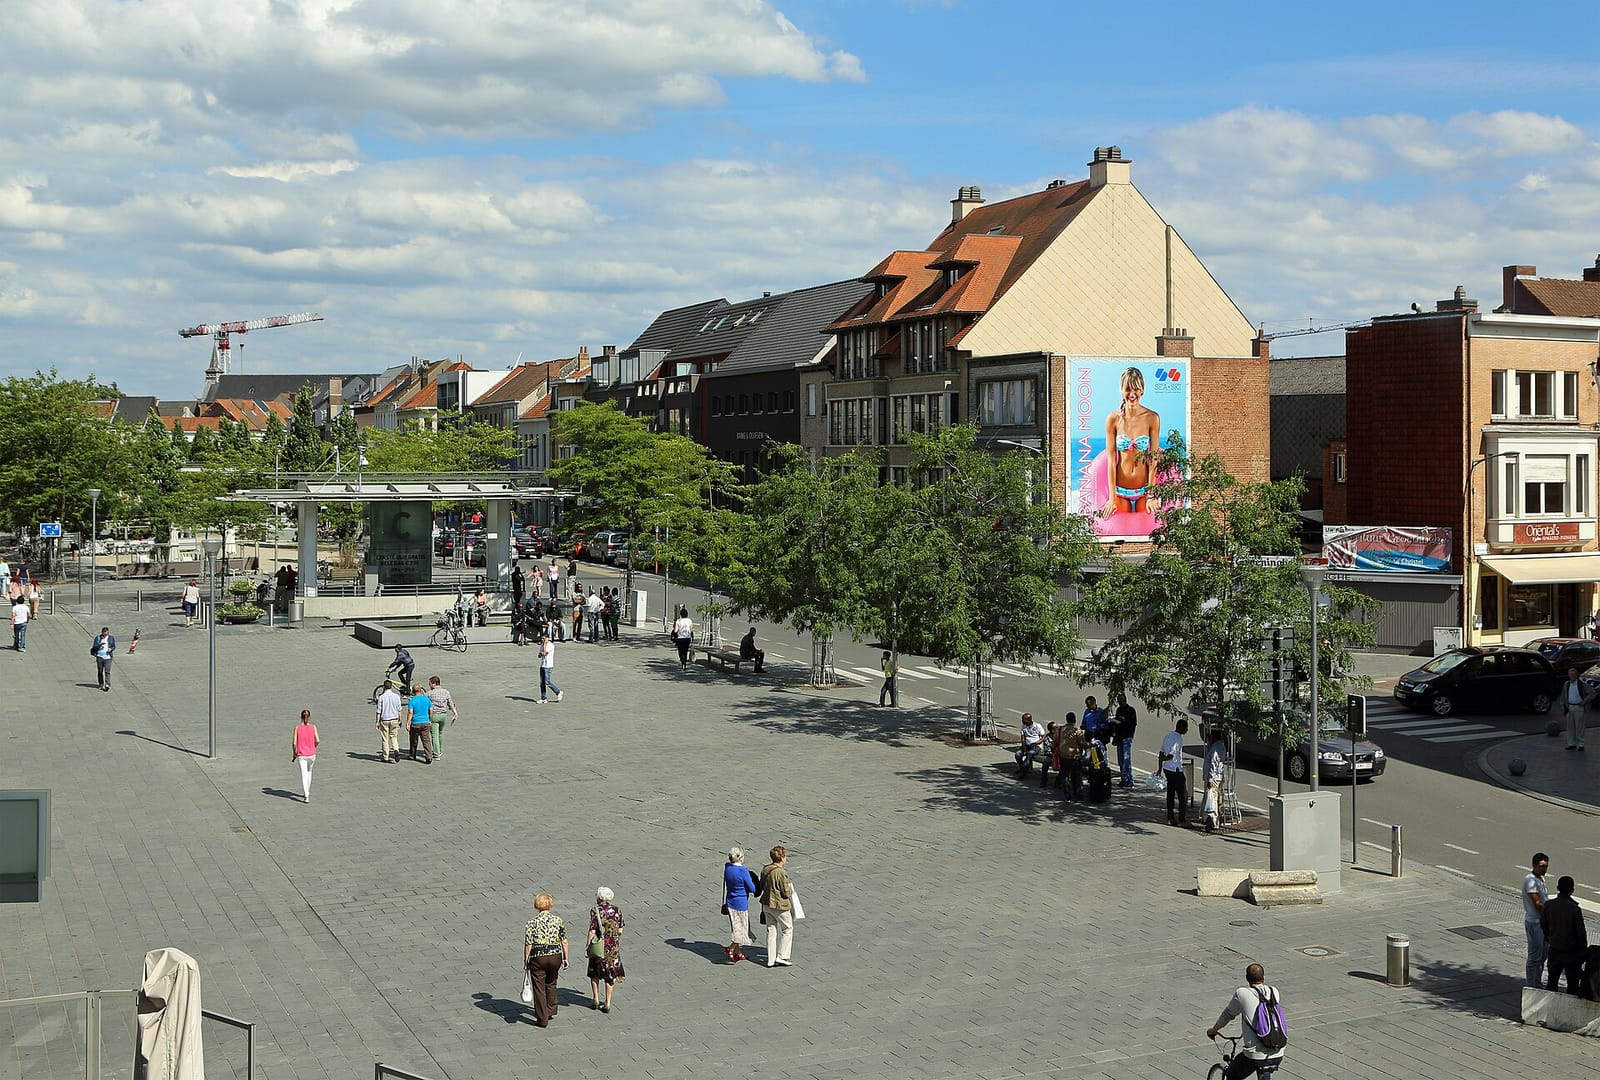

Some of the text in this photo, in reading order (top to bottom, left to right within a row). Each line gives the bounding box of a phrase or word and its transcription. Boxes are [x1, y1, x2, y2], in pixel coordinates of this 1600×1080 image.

[1078, 367, 1092, 516] BANANA MOON
[392, 511, 411, 539] C
